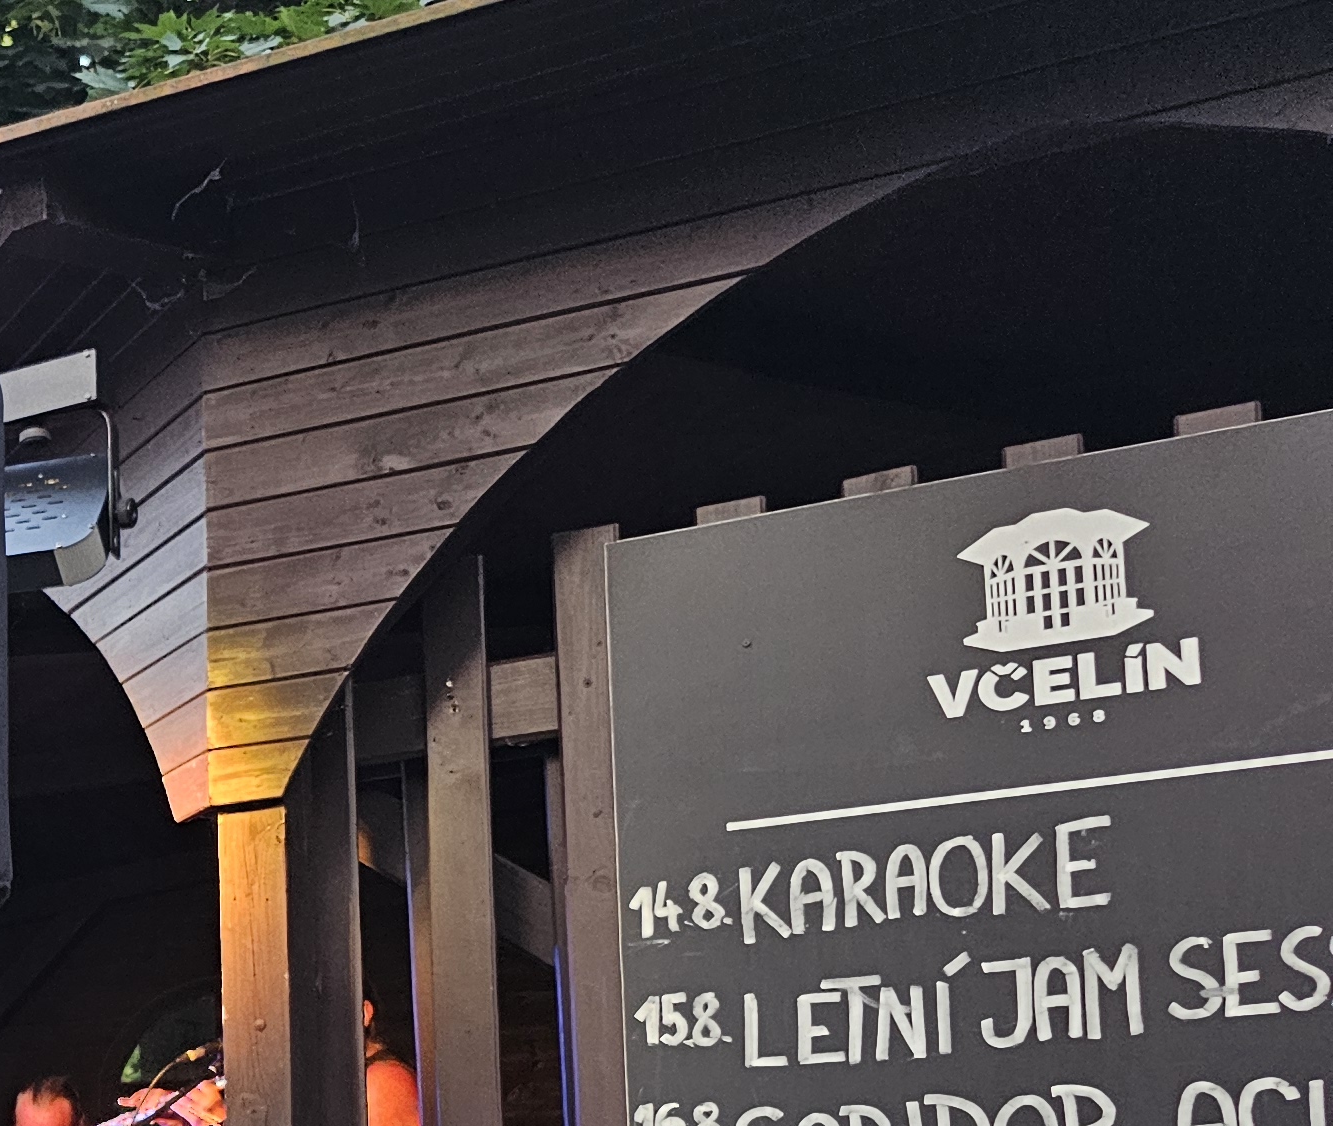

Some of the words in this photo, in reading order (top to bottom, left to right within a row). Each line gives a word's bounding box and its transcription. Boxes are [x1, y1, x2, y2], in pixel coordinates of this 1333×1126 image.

[927, 637, 1201, 718] VČELÍN
[1020, 710, 1105, 732] 1968
[739, 815, 1111, 944] KARAOKE
[744, 952, 970, 1067] LETNÍ
[981, 944, 1143, 1048] JAM
[1169, 925, 1333, 1020] SES
